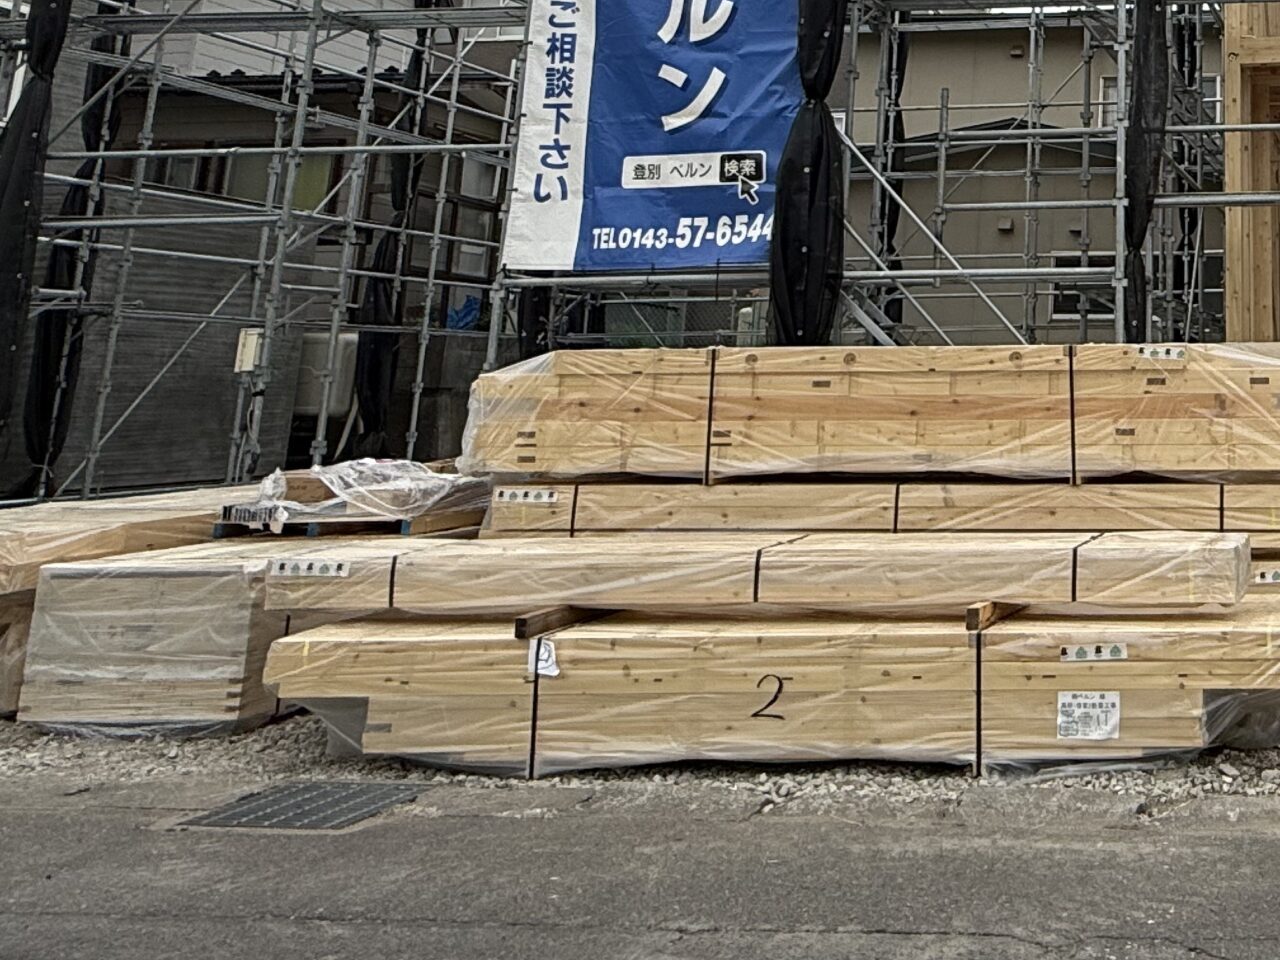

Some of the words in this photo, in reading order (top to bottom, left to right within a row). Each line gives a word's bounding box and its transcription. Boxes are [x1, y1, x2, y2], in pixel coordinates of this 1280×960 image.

[632, 163, 661, 181] 登別
[669, 161, 713, 179] ベルン
[724, 159, 757, 178] 検索
[751, 674, 786, 720] 2
